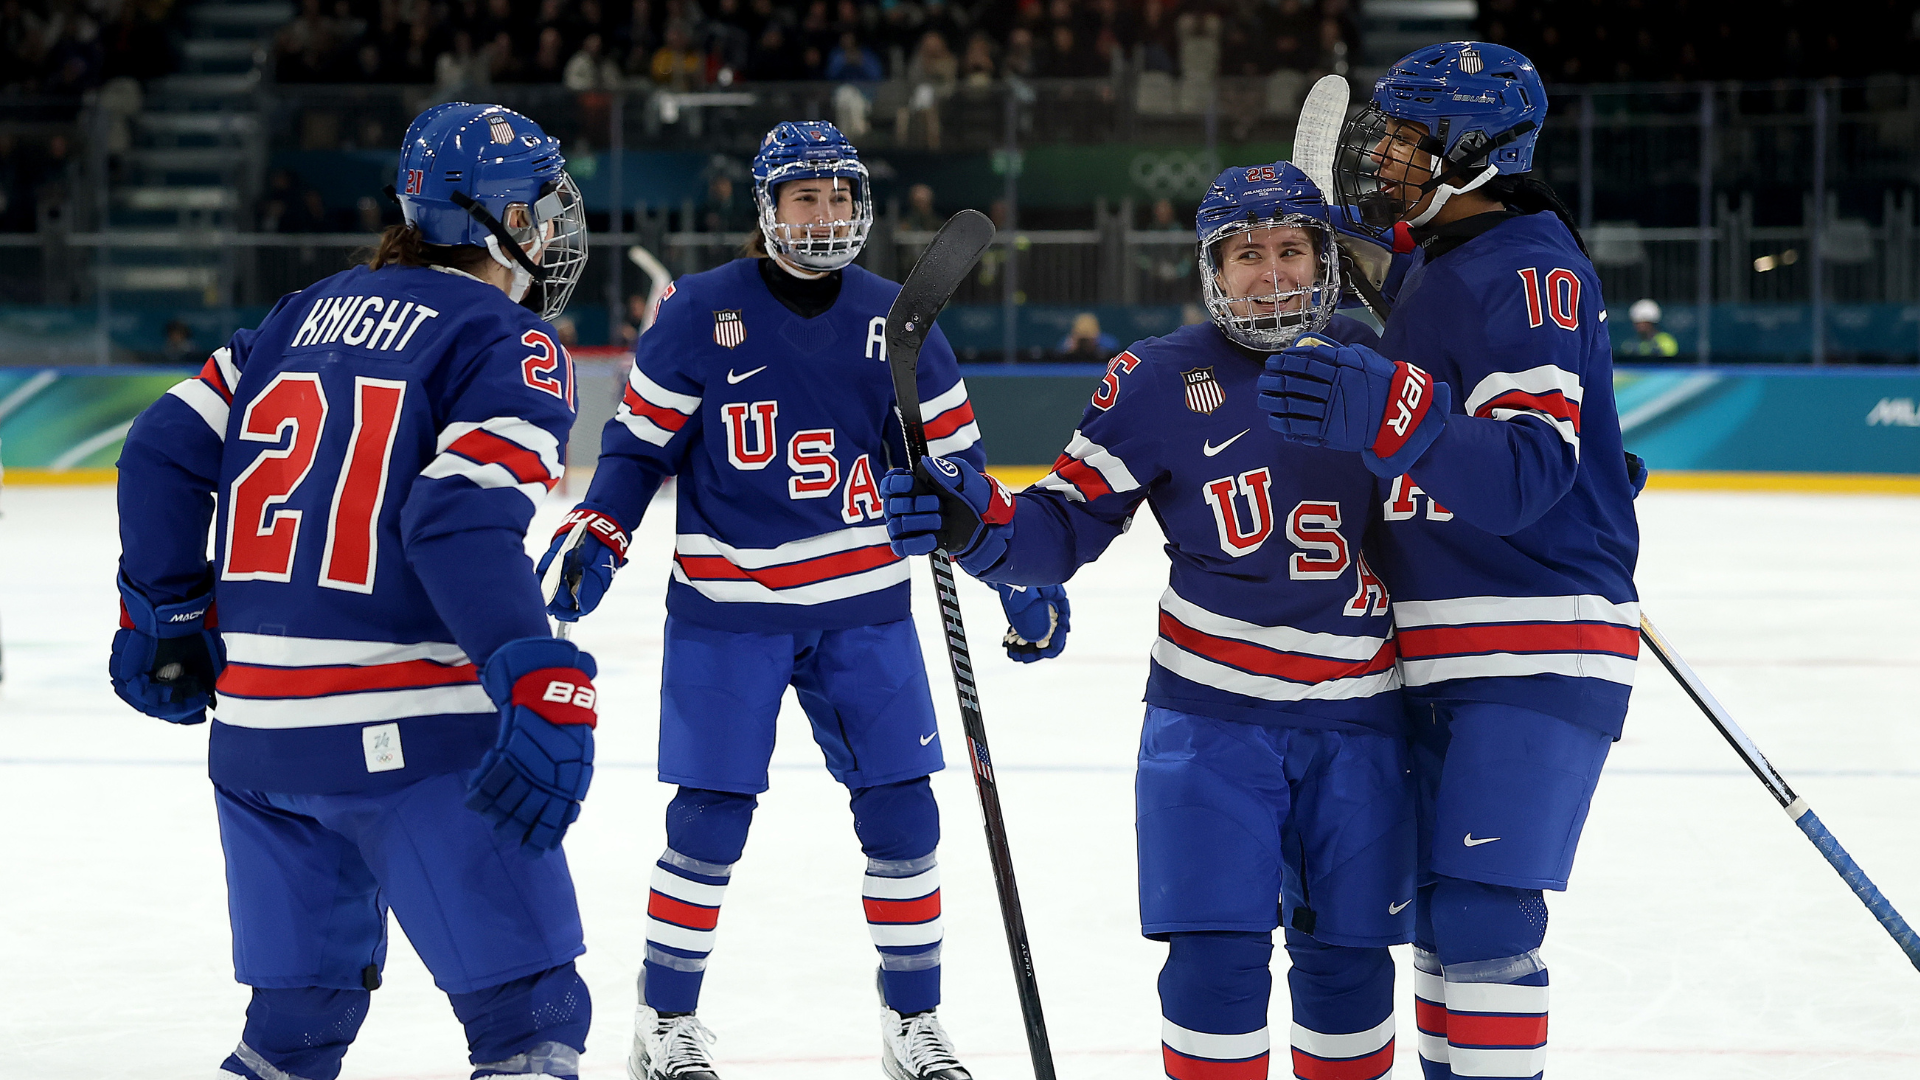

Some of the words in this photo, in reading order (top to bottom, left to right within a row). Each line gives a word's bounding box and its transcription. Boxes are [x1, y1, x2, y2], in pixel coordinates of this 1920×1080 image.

[490, 116, 505, 124] USA
[405, 169, 423, 195] 21
[1246, 166, 1276, 183] 25
[718, 312, 738, 322] USA
[1517, 267, 1581, 332] 10
[291, 295, 440, 351] KNIGHT
[865, 316, 887, 362] A
[1091, 350, 1142, 411] 5
[1188, 371, 1211, 383] USA
[221, 371, 407, 595] 21
[721, 400, 884, 525] USA
[1202, 467, 1390, 617] USA
[1021, 943, 1032, 977] ALPHA
